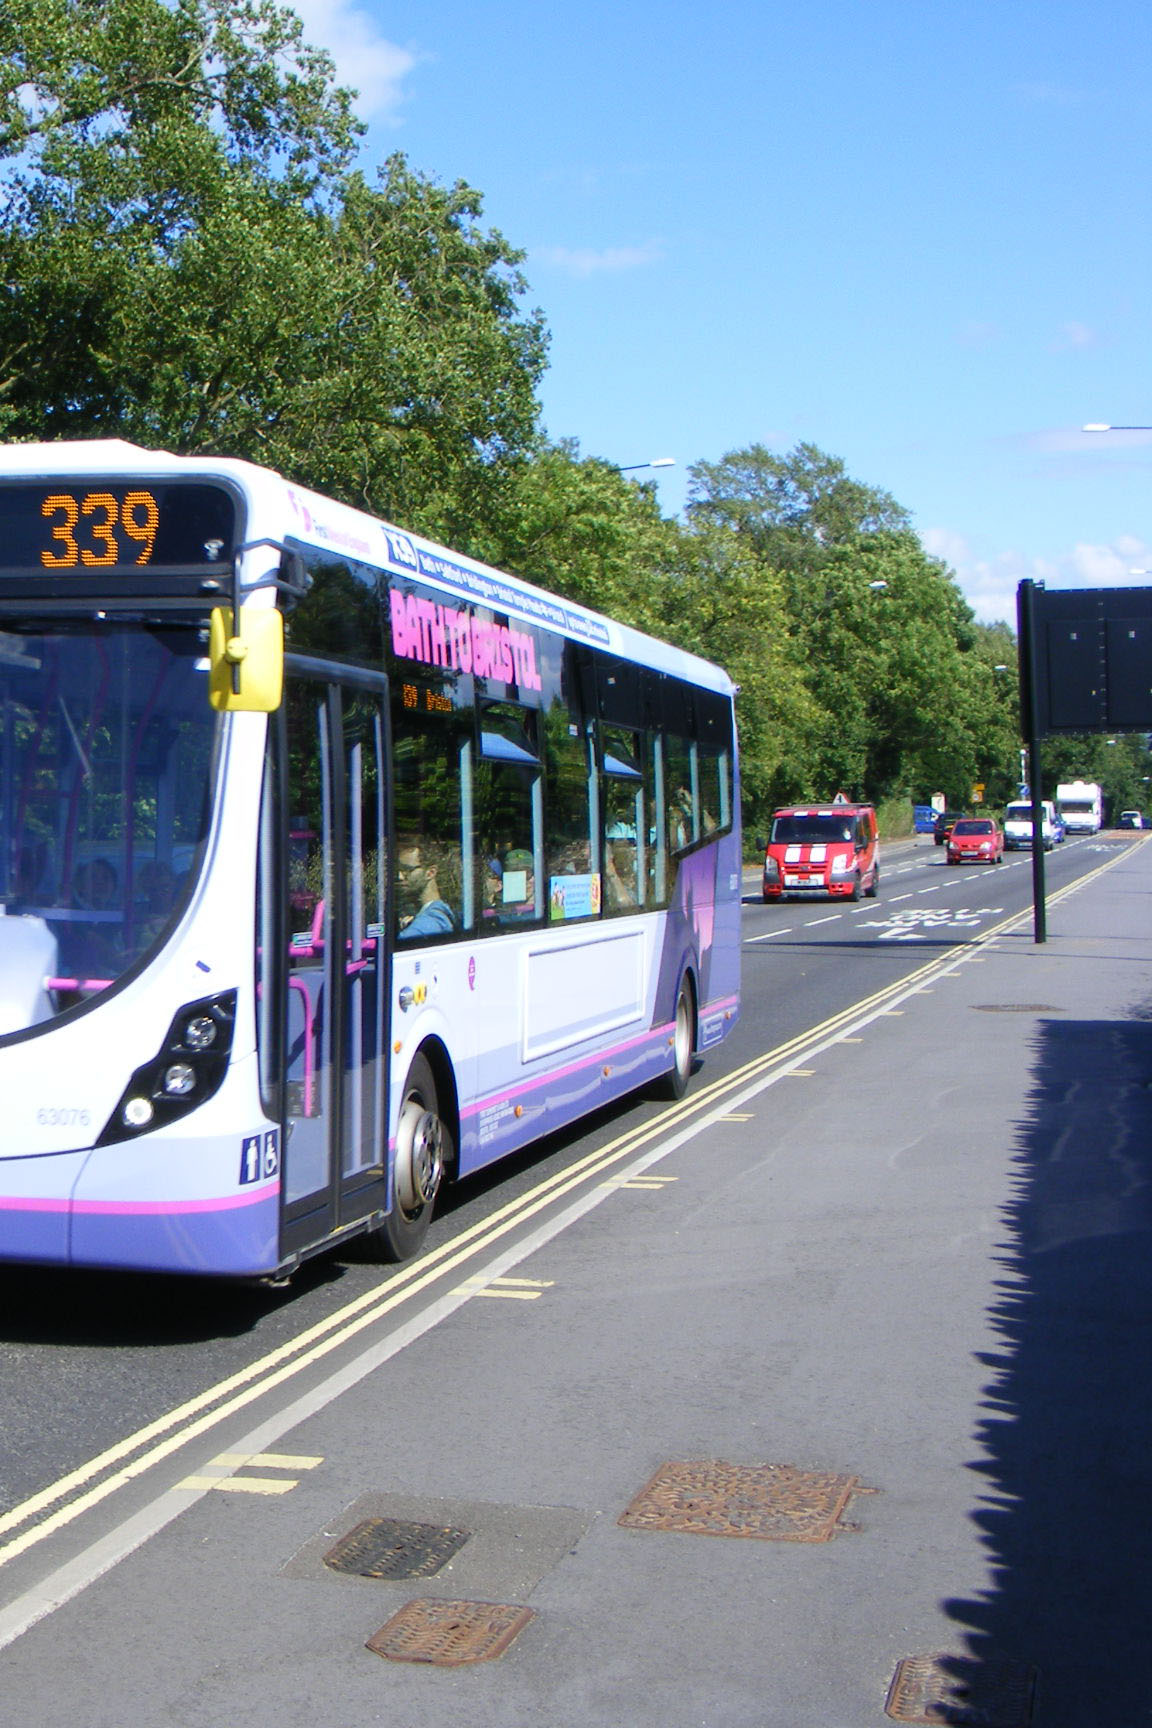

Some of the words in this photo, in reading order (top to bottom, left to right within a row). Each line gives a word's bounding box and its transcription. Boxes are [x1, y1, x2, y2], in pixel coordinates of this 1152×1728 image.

[41, 491, 160, 568] 339
[390, 588, 449, 667] BATH
[444, 607, 473, 674] TO
[471, 616, 542, 691] BRISTOL
[37, 1107, 91, 1128] 63076
